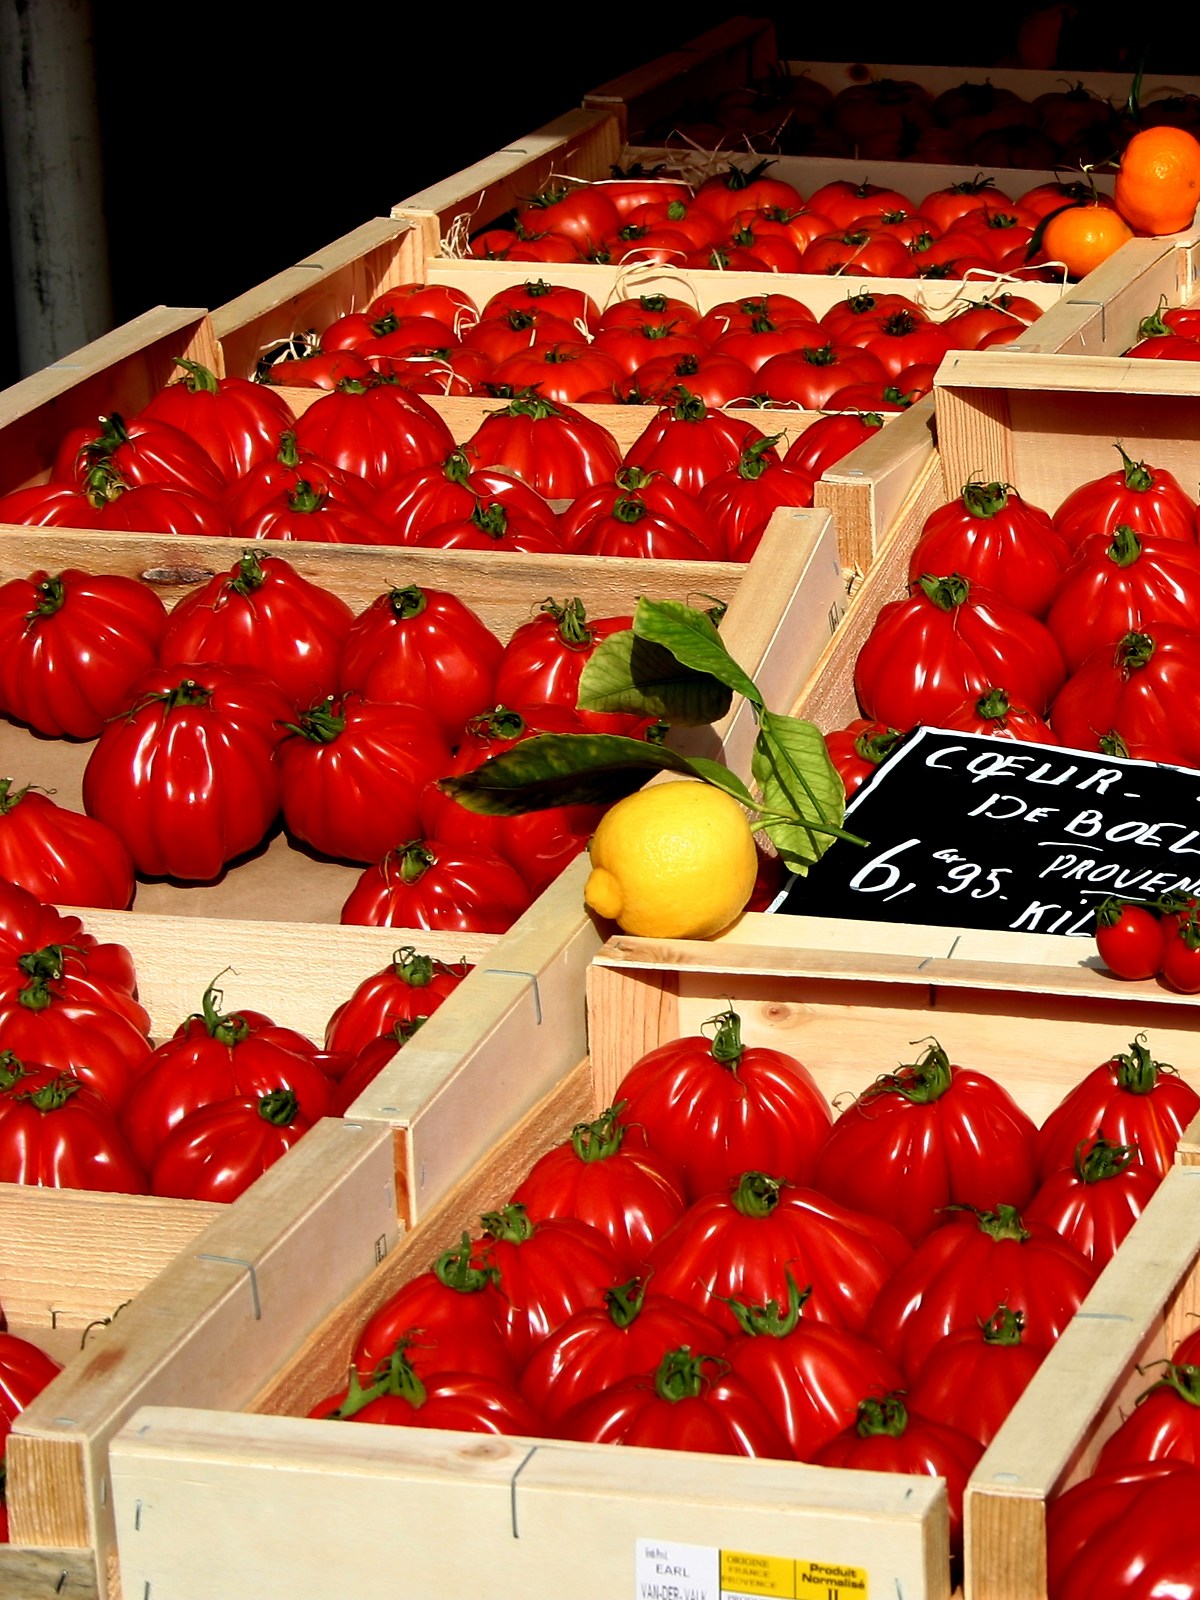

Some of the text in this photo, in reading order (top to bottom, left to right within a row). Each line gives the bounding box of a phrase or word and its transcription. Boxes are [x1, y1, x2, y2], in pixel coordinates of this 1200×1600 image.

[967, 793, 1060, 822] DE
[656, 1564, 689, 1578] EARL
[810, 1563, 857, 1577] Produit
[802, 1574, 866, 1589] Normalisé
